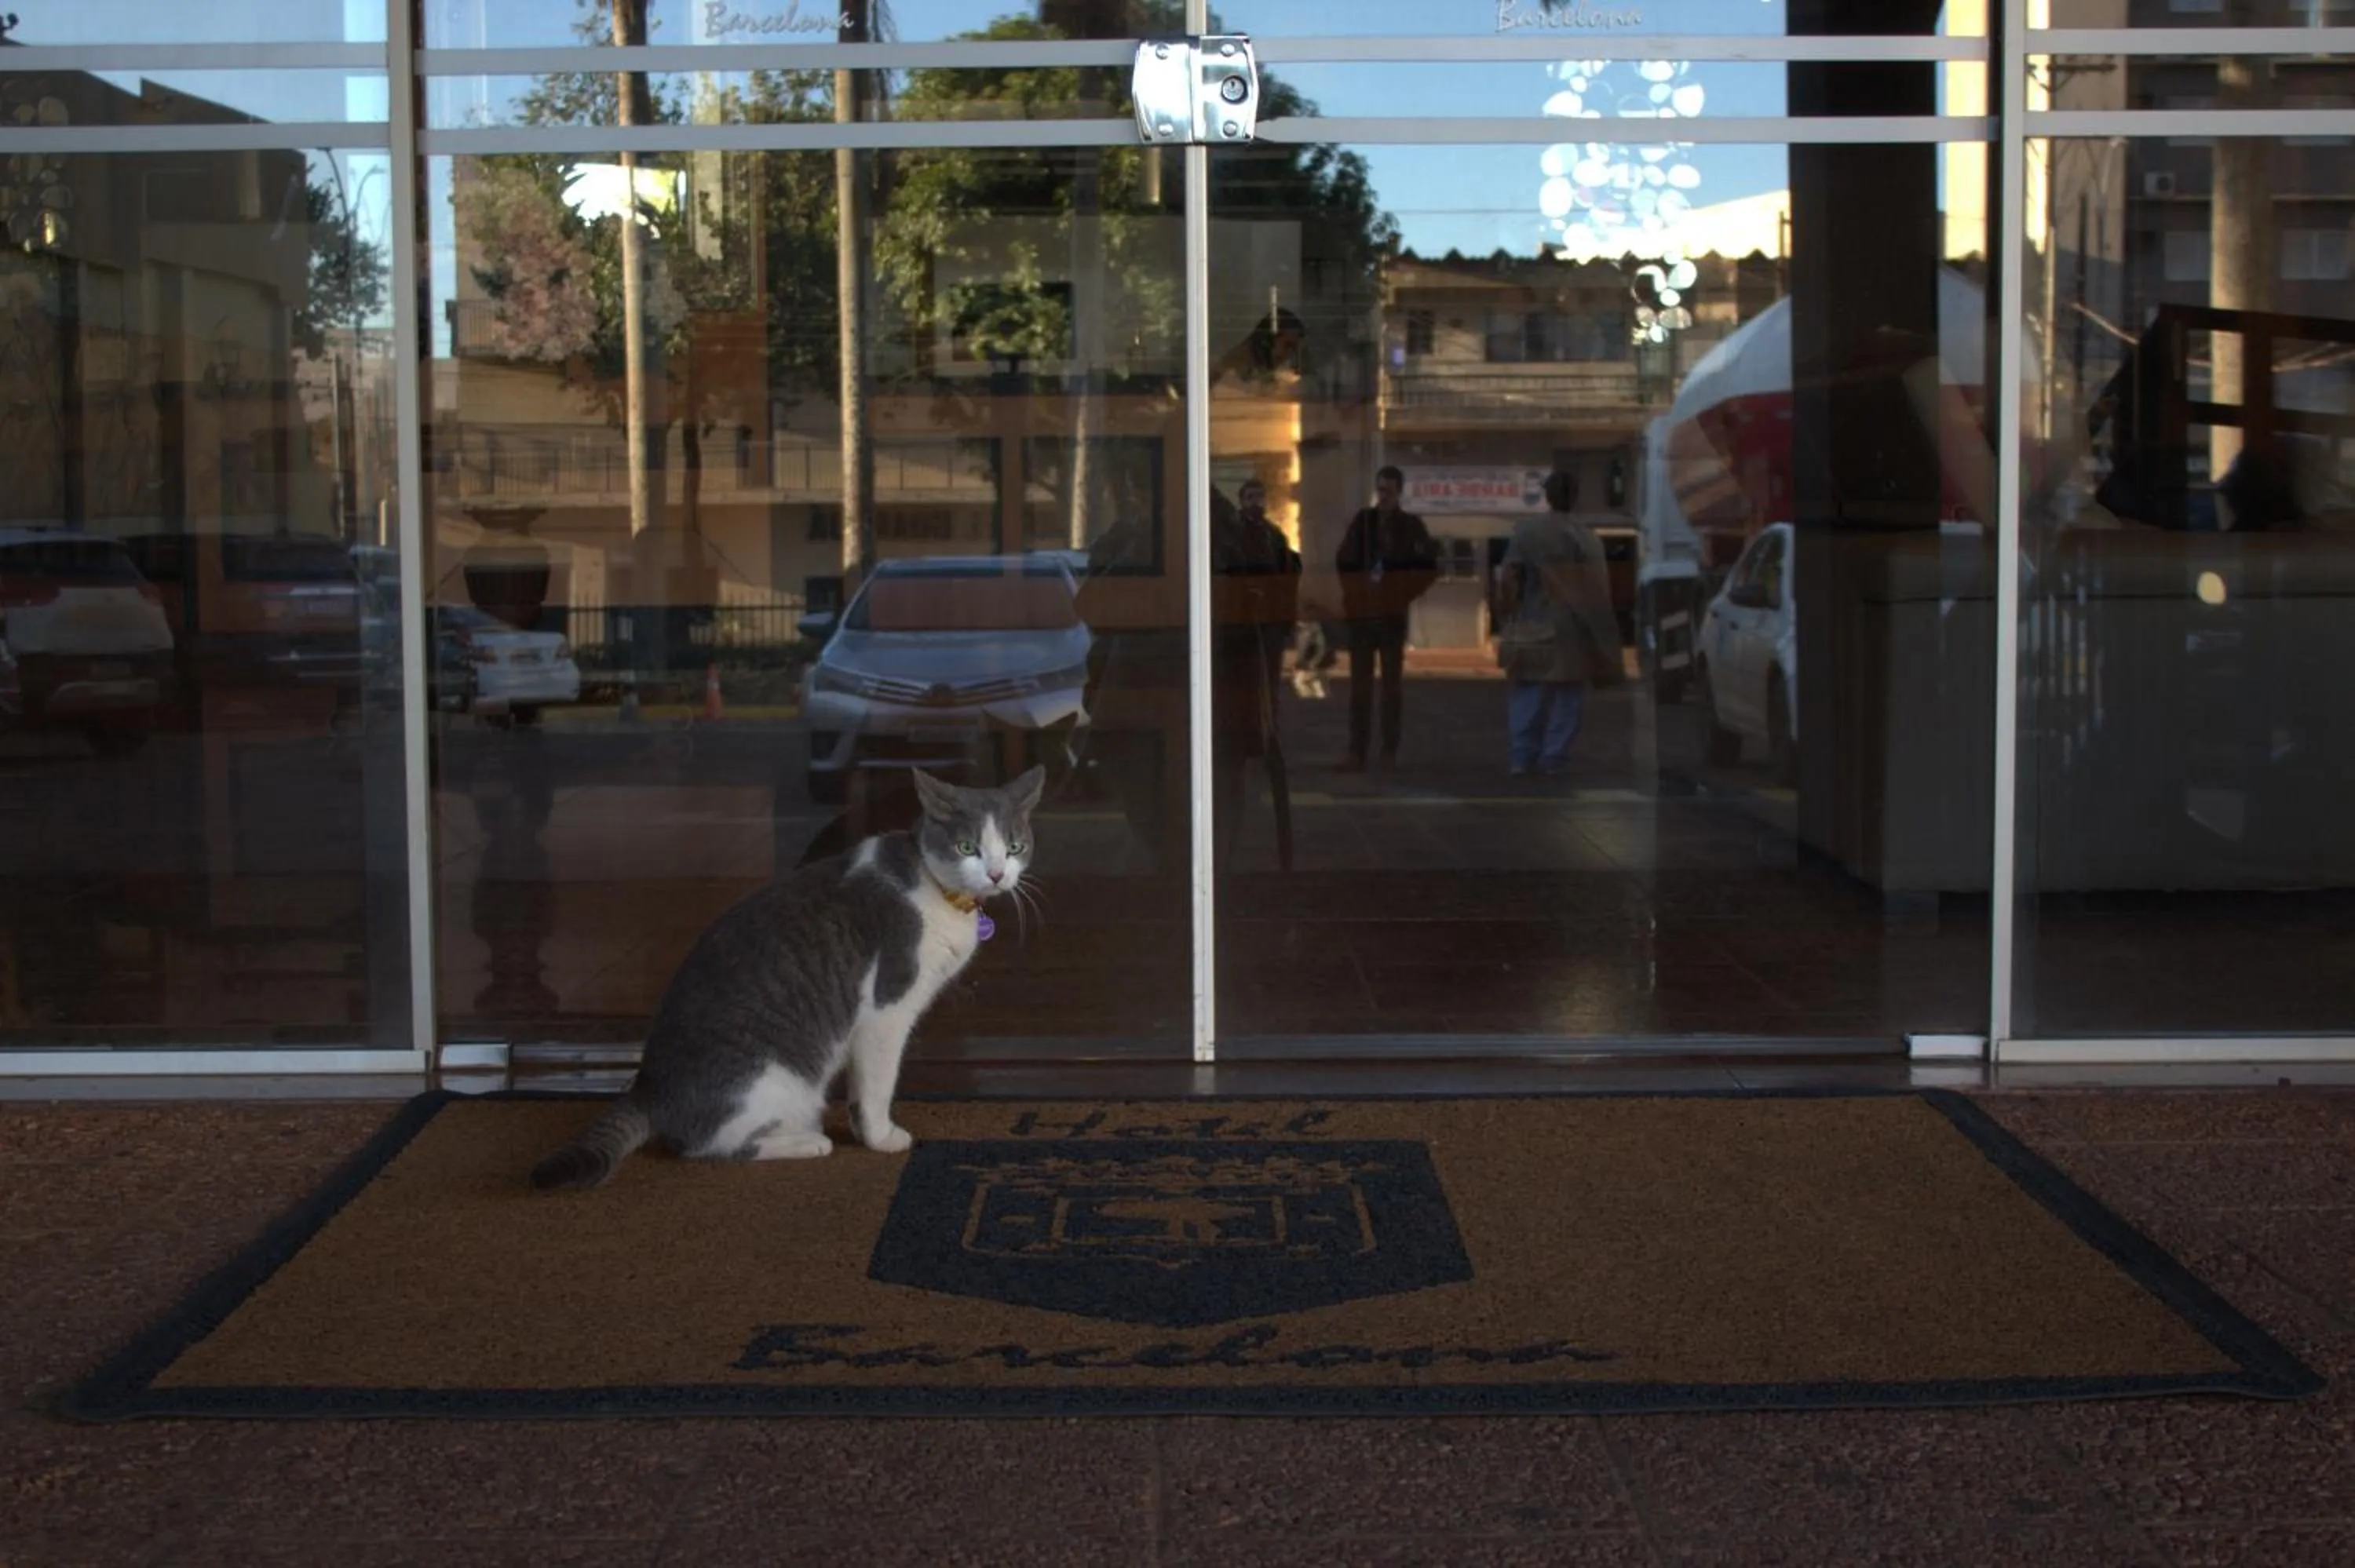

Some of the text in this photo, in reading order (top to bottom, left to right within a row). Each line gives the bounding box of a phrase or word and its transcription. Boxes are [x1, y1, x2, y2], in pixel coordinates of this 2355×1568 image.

[705, 1, 856, 36] Barcelona
[1495, 0, 1644, 32] Barcelona
[732, 1323, 1616, 1369] Barcelona
